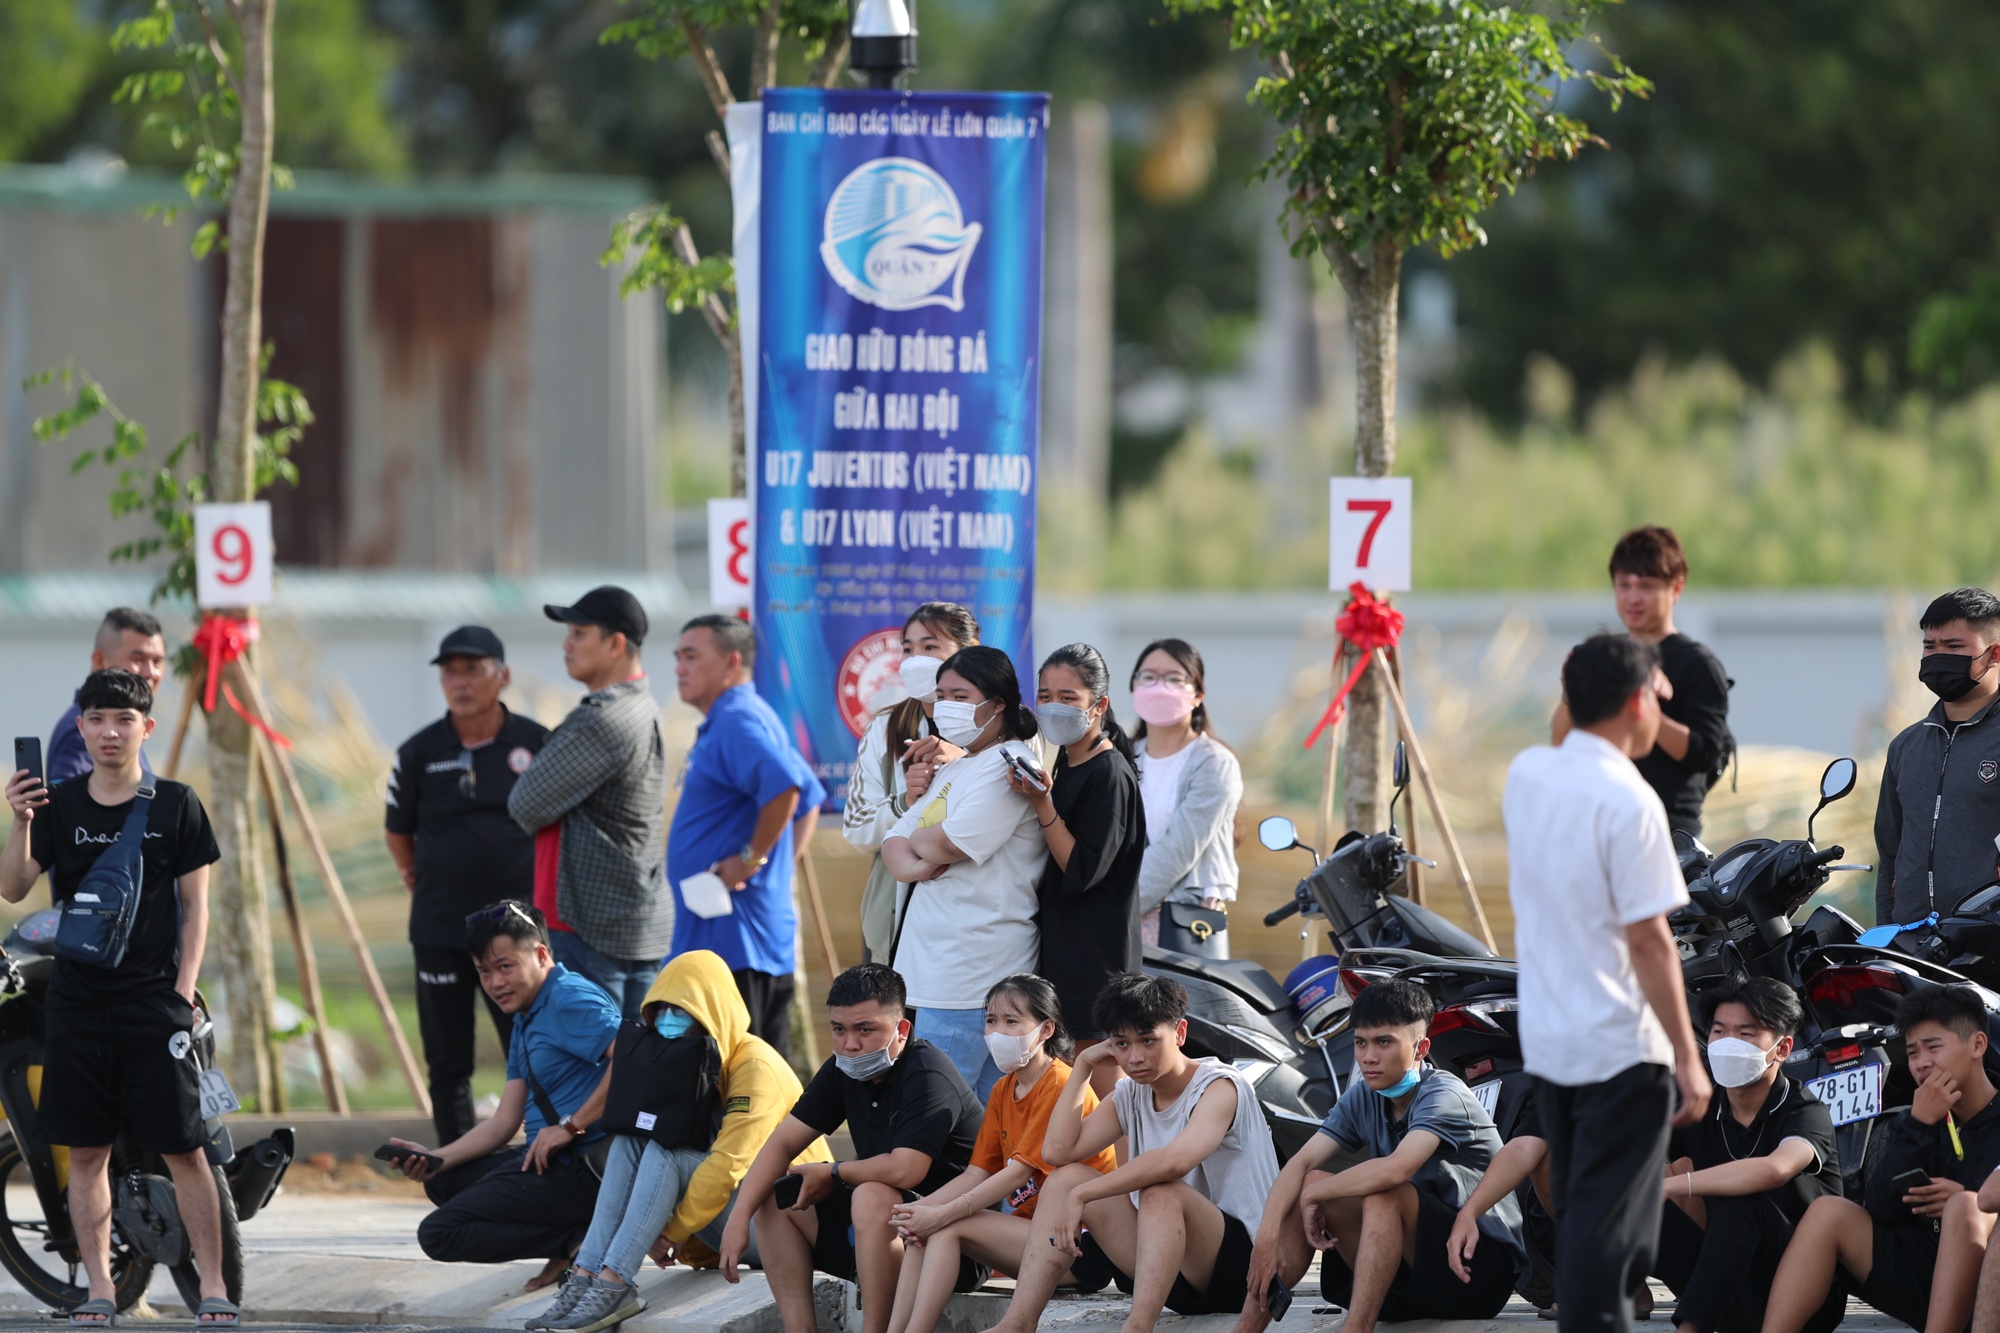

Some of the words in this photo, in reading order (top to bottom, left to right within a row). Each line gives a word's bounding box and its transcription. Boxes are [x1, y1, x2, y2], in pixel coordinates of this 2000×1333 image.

[860, 108, 889, 136] CÁC
[1027, 117, 1039, 139] 7
[805, 332, 853, 372] GIAO
[856, 326, 897, 373] HỮU
[900, 328, 955, 373] BÓNG
[958, 329, 989, 374] ĐÁ
[834, 385, 881, 431] GIỮA
[883, 392, 919, 431] HAI
[922, 387, 960, 439] ĐỘI
[765, 449, 804, 488] U17
[807, 450, 910, 490] JUVENTUS
[913, 446, 970, 498] (VIỆT
[973, 452, 1031, 496] NAM)
[212, 523, 254, 587] 9
[780, 507, 797, 547] &
[801, 508, 839, 547] U17
[841, 508, 895, 548] LYON
[898, 504, 955, 556] (VIỆT
[957, 510, 1015, 555] NAM)
[1346, 499, 1393, 569] 7
[1817, 1069, 1867, 1100] 78-G1
[1834, 1060, 1858, 1070] HONDA
